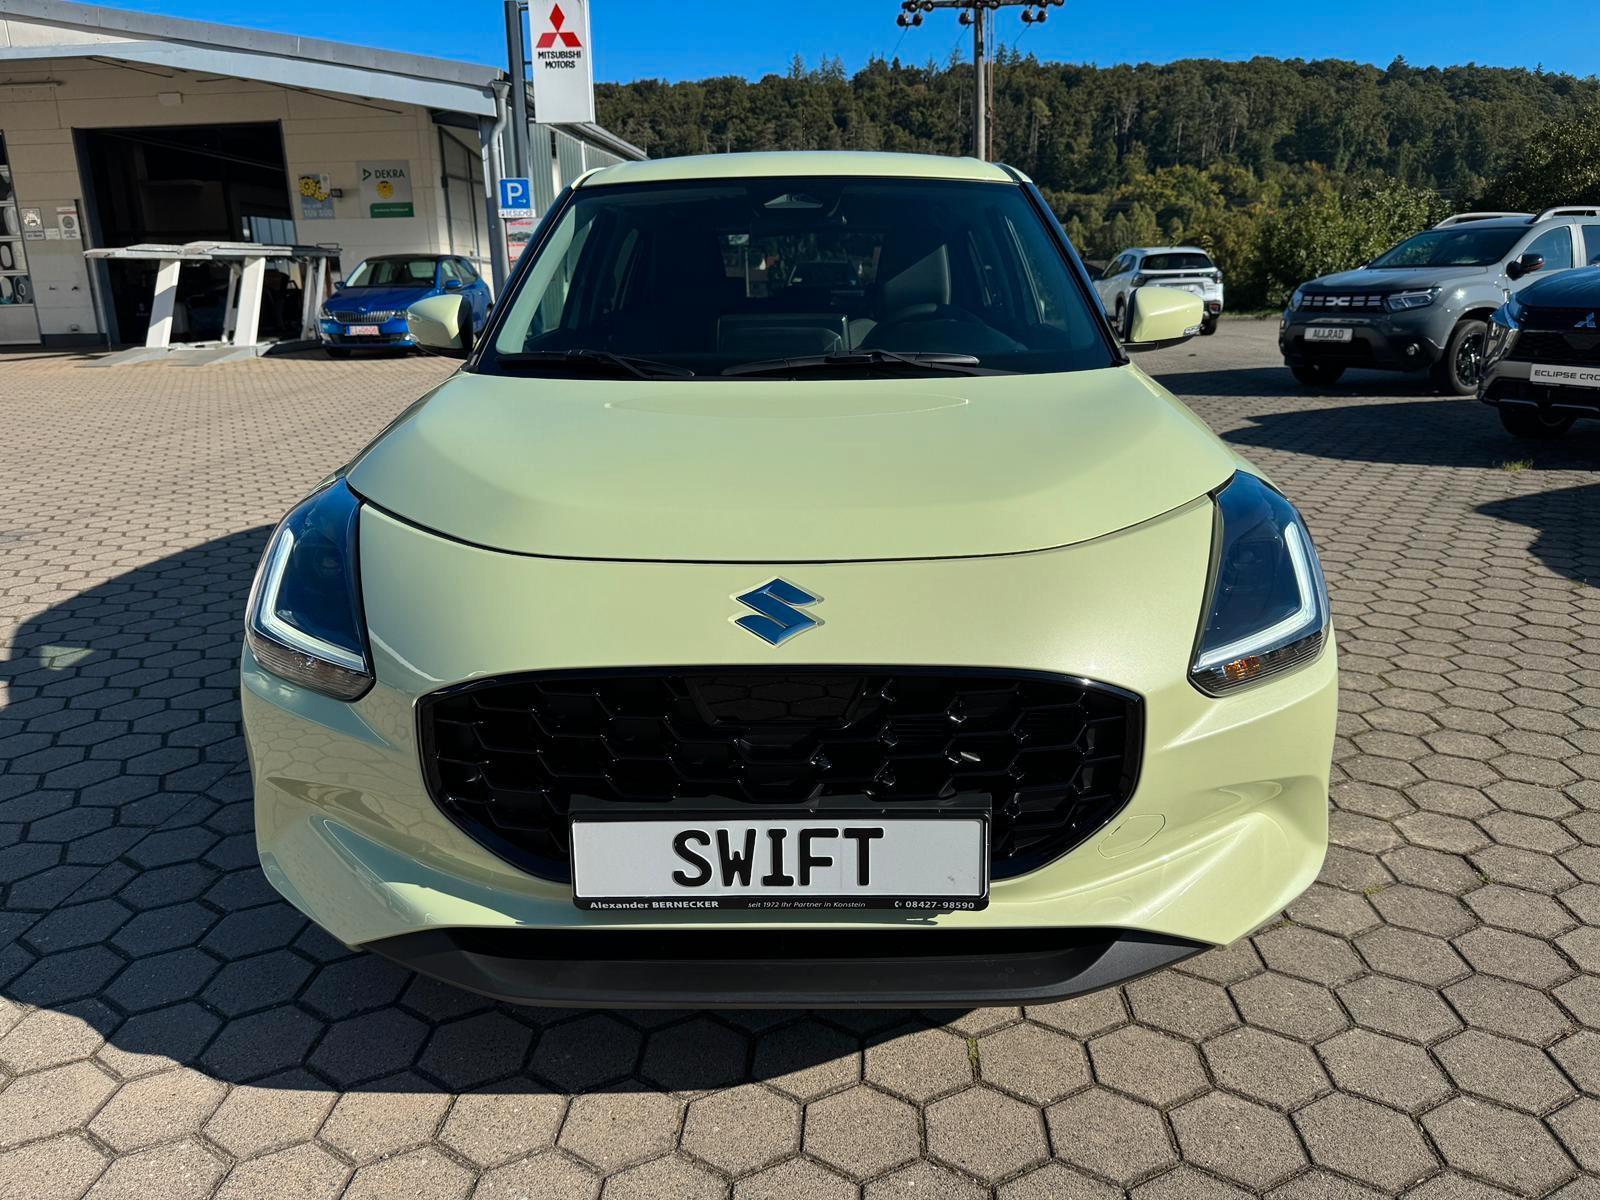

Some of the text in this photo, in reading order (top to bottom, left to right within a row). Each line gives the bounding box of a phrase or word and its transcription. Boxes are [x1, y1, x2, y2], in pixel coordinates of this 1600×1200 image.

[538, 51, 581, 59] MITSUBISHI
[545, 61, 576, 69] MOTORS
[374, 168, 406, 179] DEKRA
[506, 182, 523, 206] P
[1312, 329, 1345, 339] ALLRAD
[1535, 370, 1577, 379] ECLIPSE
[672, 828, 884, 887] SWIFT
[905, 900, 975, 909] 08427-98590
